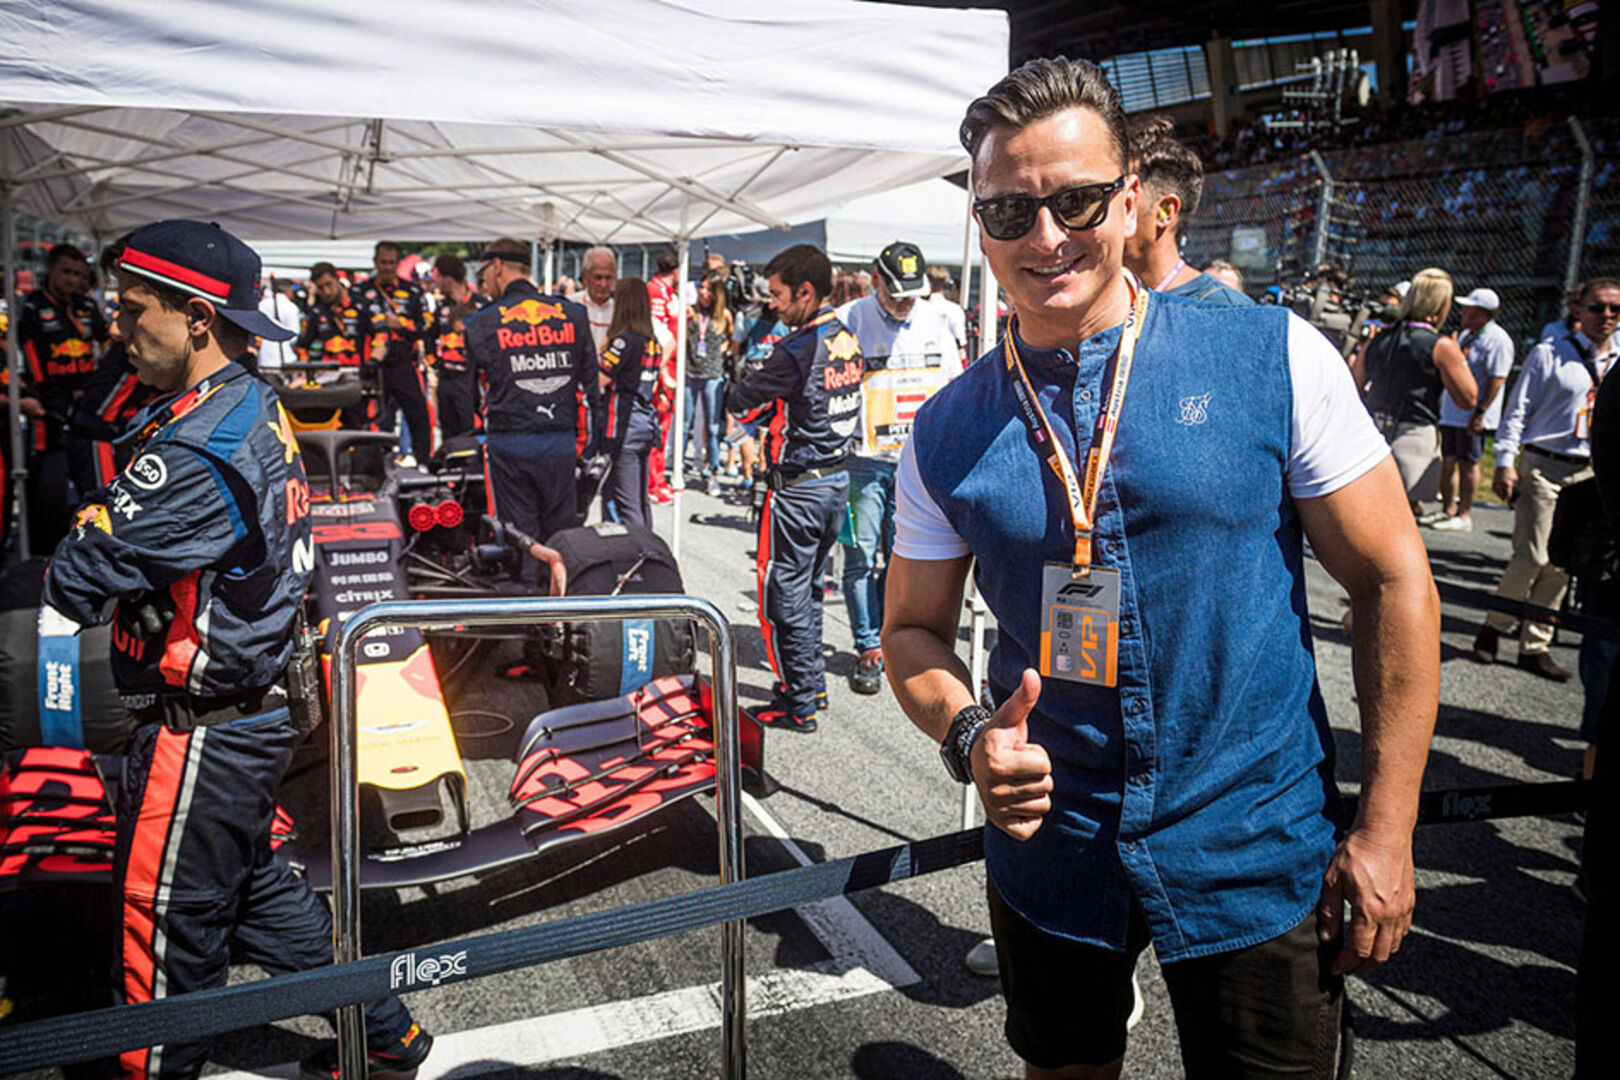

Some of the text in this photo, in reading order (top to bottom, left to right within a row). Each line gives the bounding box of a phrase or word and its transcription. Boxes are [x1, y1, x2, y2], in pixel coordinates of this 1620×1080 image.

[510, 351, 557, 373] Mobil
[1108, 379, 1125, 416] Austria
[330, 551, 389, 567] JUMBO
[627, 626, 639, 662] Left
[637, 629, 649, 673] Front
[1080, 614, 1099, 679] VIP
[44, 660, 59, 711] Front
[58, 663, 75, 712] Right
[389, 950, 468, 990] flex
